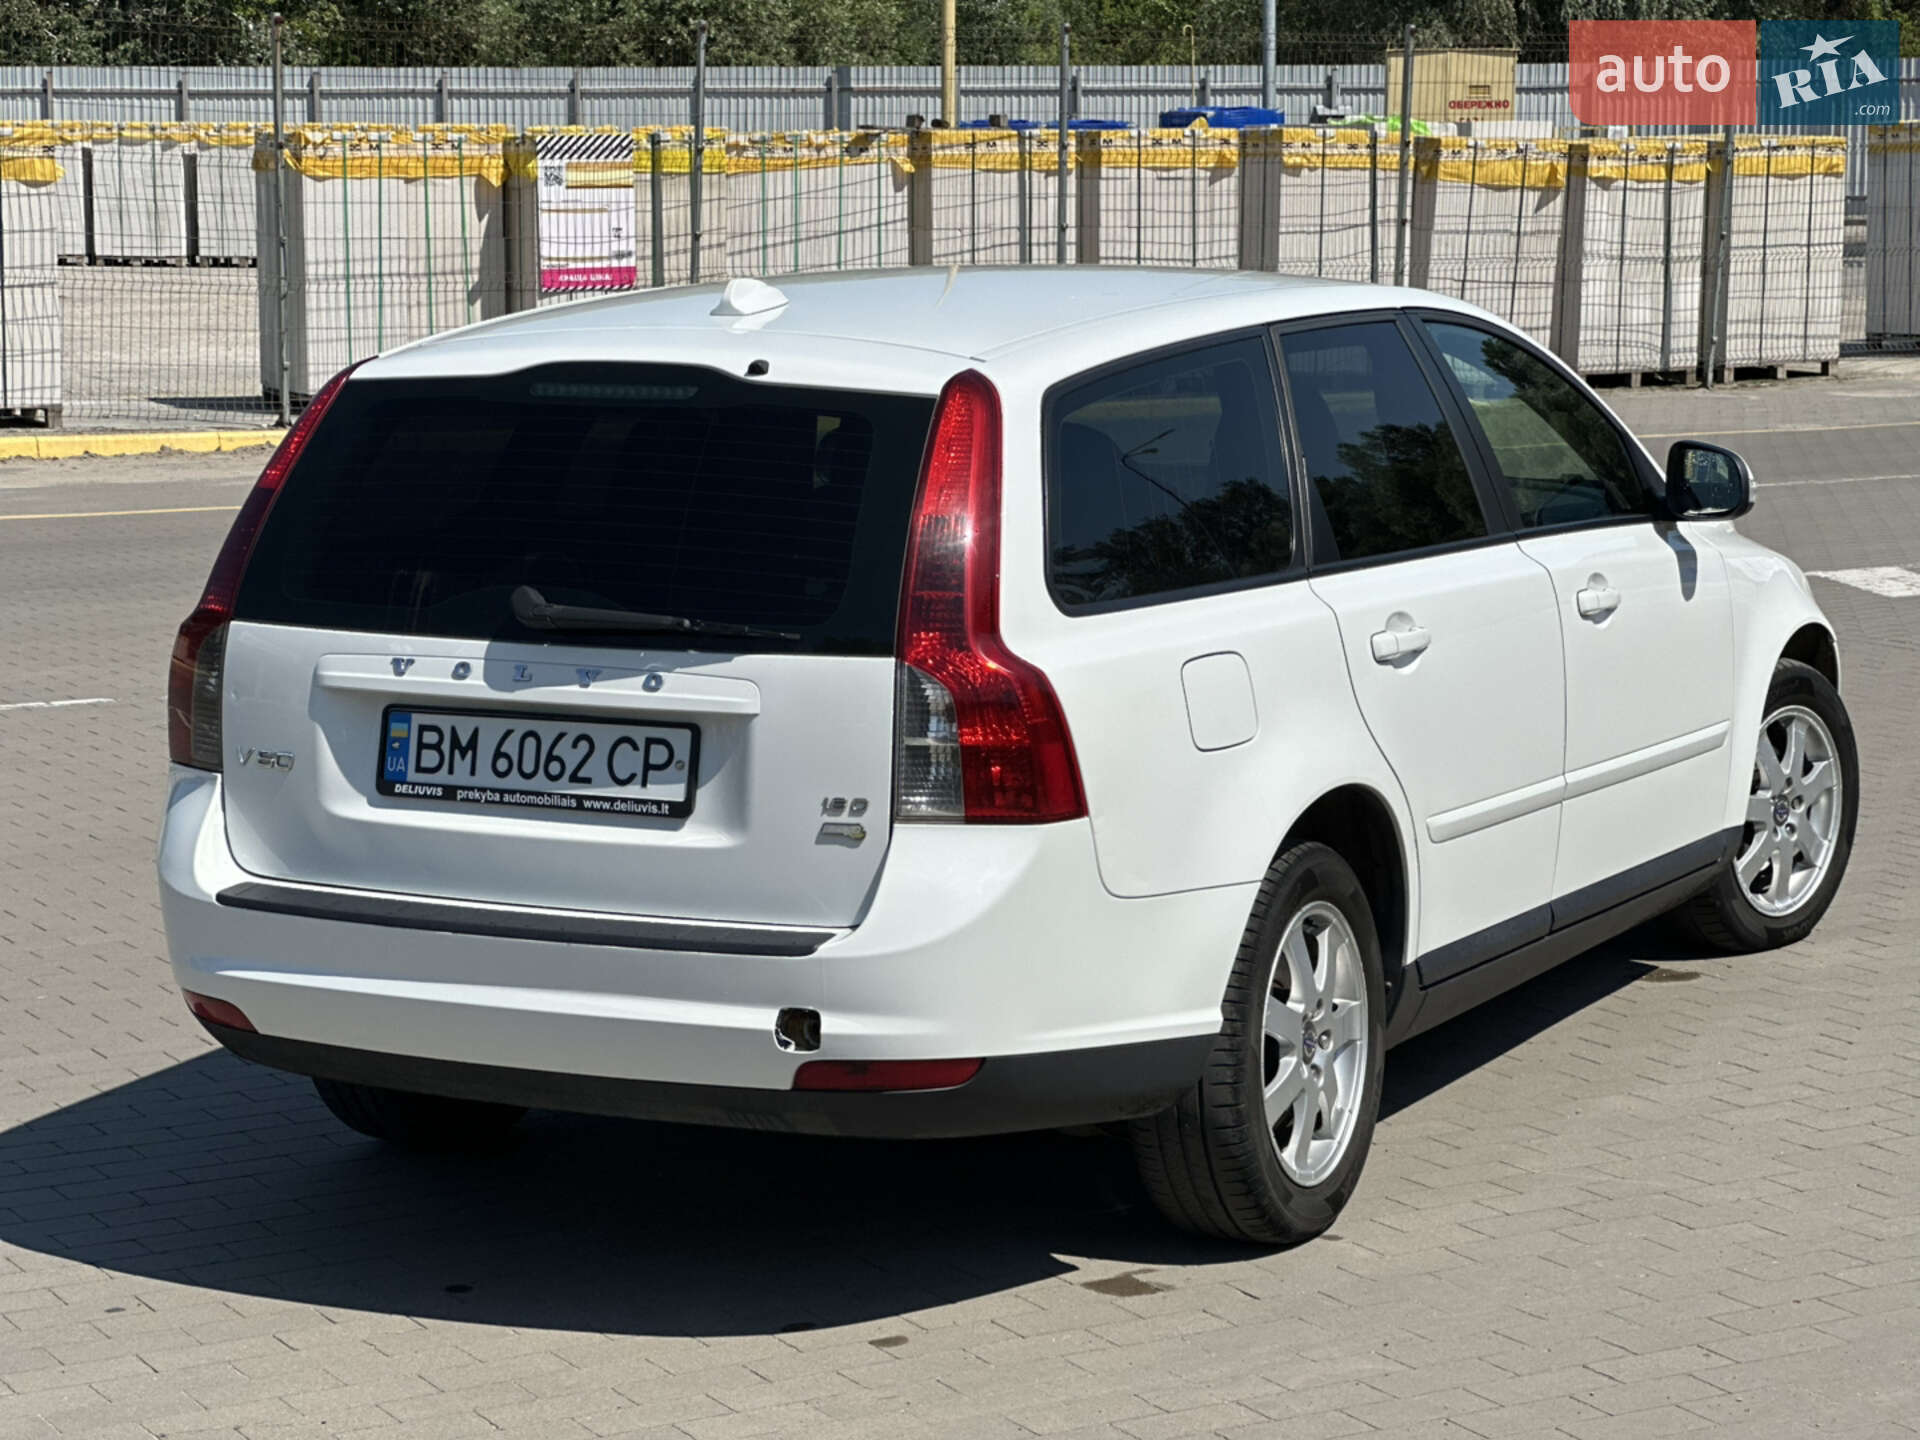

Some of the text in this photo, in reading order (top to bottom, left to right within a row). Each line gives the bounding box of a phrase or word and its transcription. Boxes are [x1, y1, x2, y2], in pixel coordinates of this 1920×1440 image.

[1448, 99, 1510, 110] ОБЕРЕЖНО
[390, 657, 664, 693] VOLVO
[235, 745, 296, 772] V50
[387, 755, 406, 773] UA
[414, 724, 675, 789] BM 6062 CP
[394, 783, 670, 815] DELIUVIS prekyba automobiliais www.deliuvis.lt
